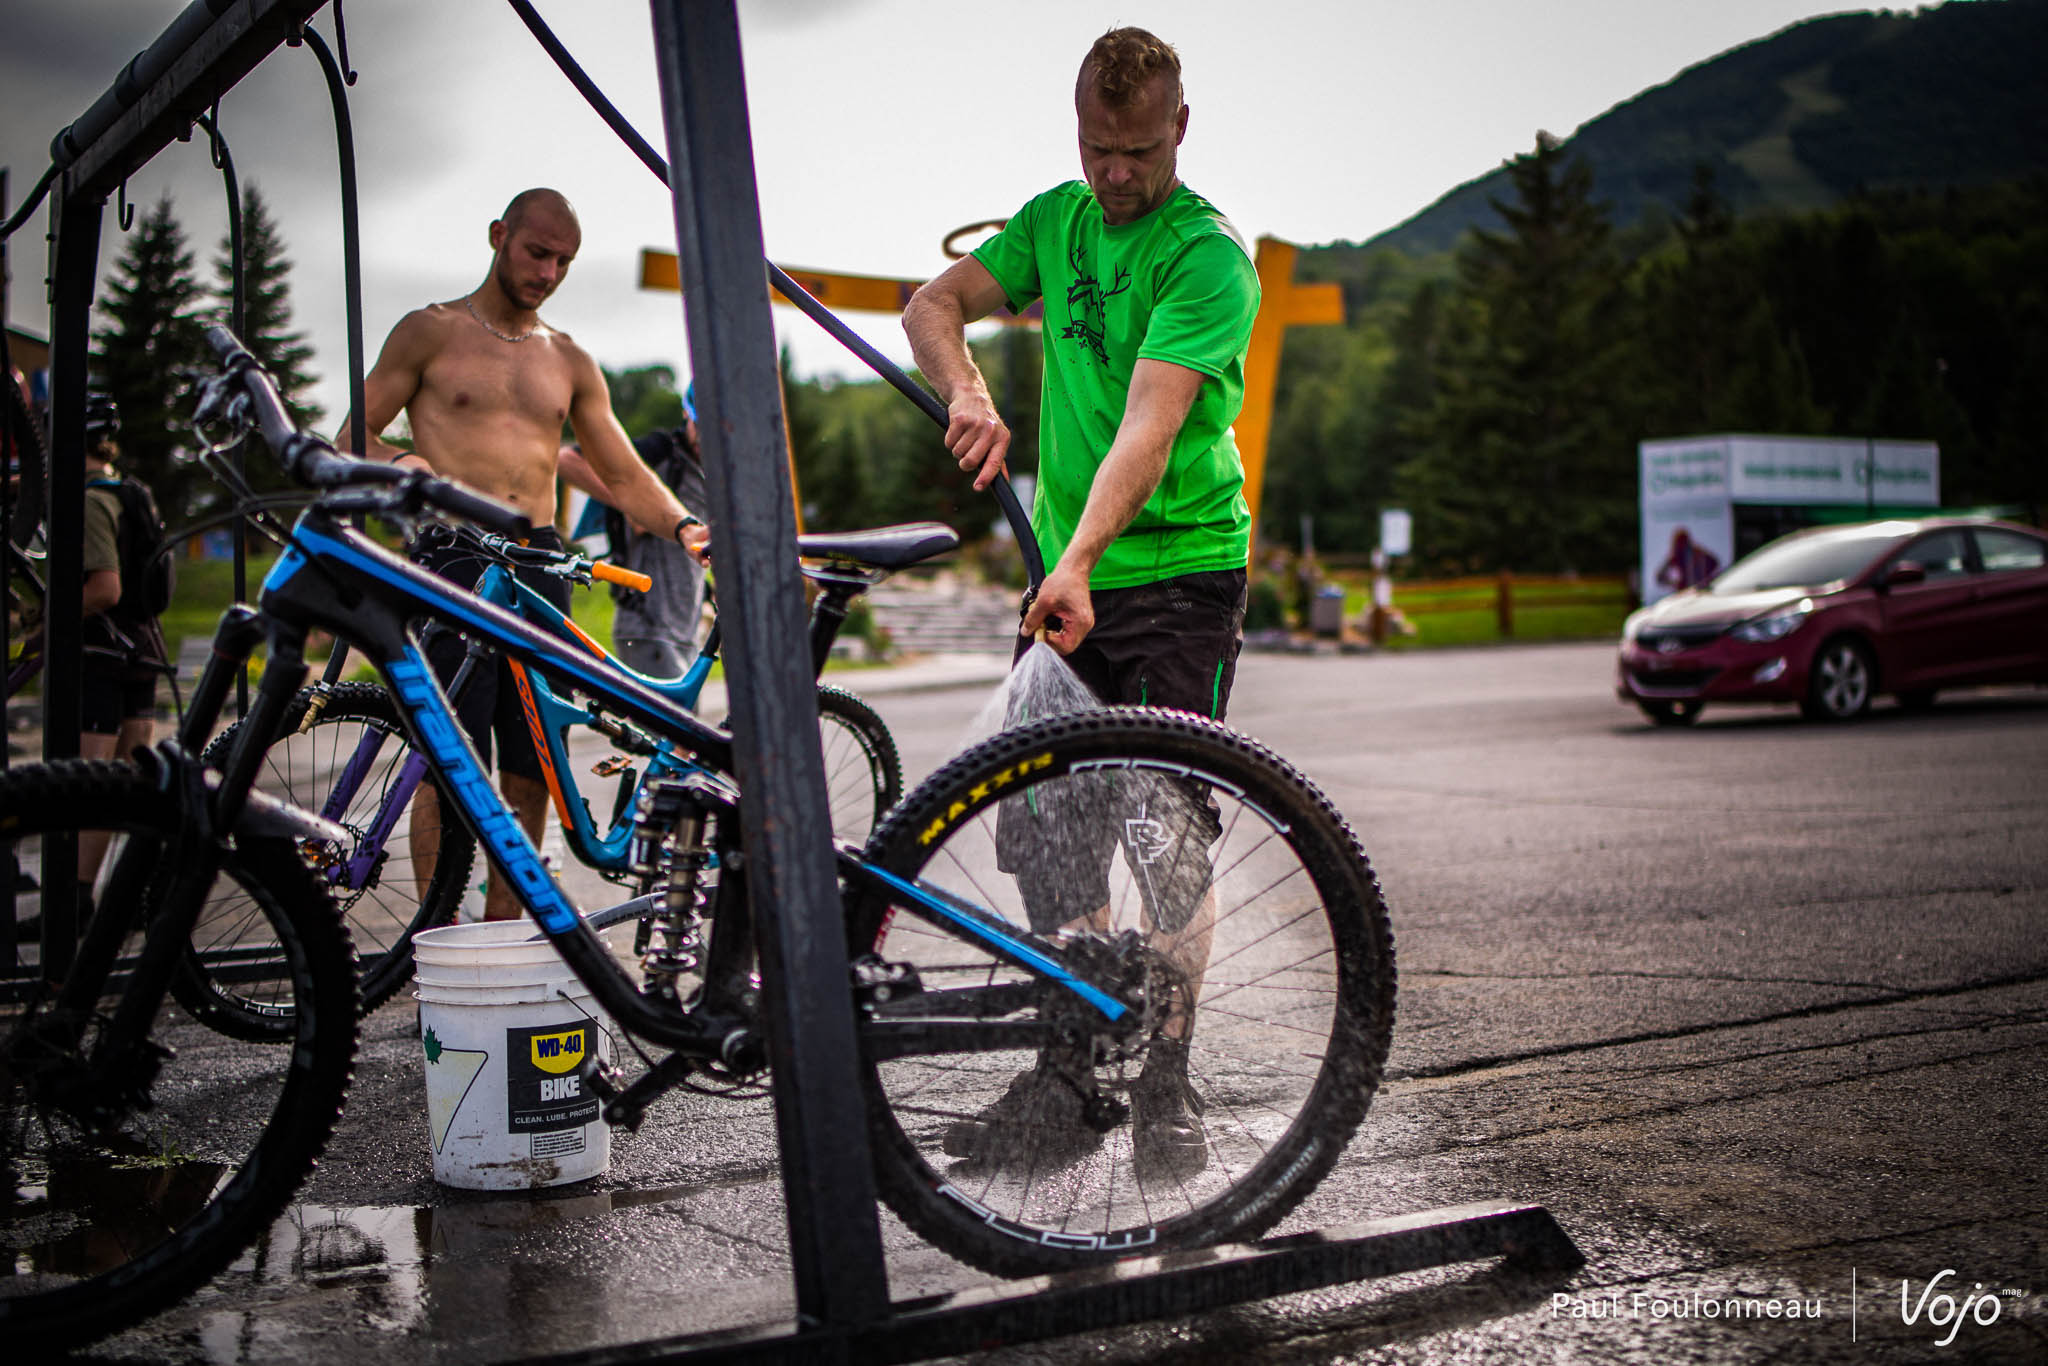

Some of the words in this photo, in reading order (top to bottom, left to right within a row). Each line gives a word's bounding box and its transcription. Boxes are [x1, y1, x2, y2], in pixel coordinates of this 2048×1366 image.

[918, 752, 1053, 845] MAXXIS
[536, 1034, 581, 1058] WD-40
[541, 1074, 580, 1101] BIKE
[514, 1116, 544, 1124] CLEAN.
[546, 1112, 568, 1121] LUBE.
